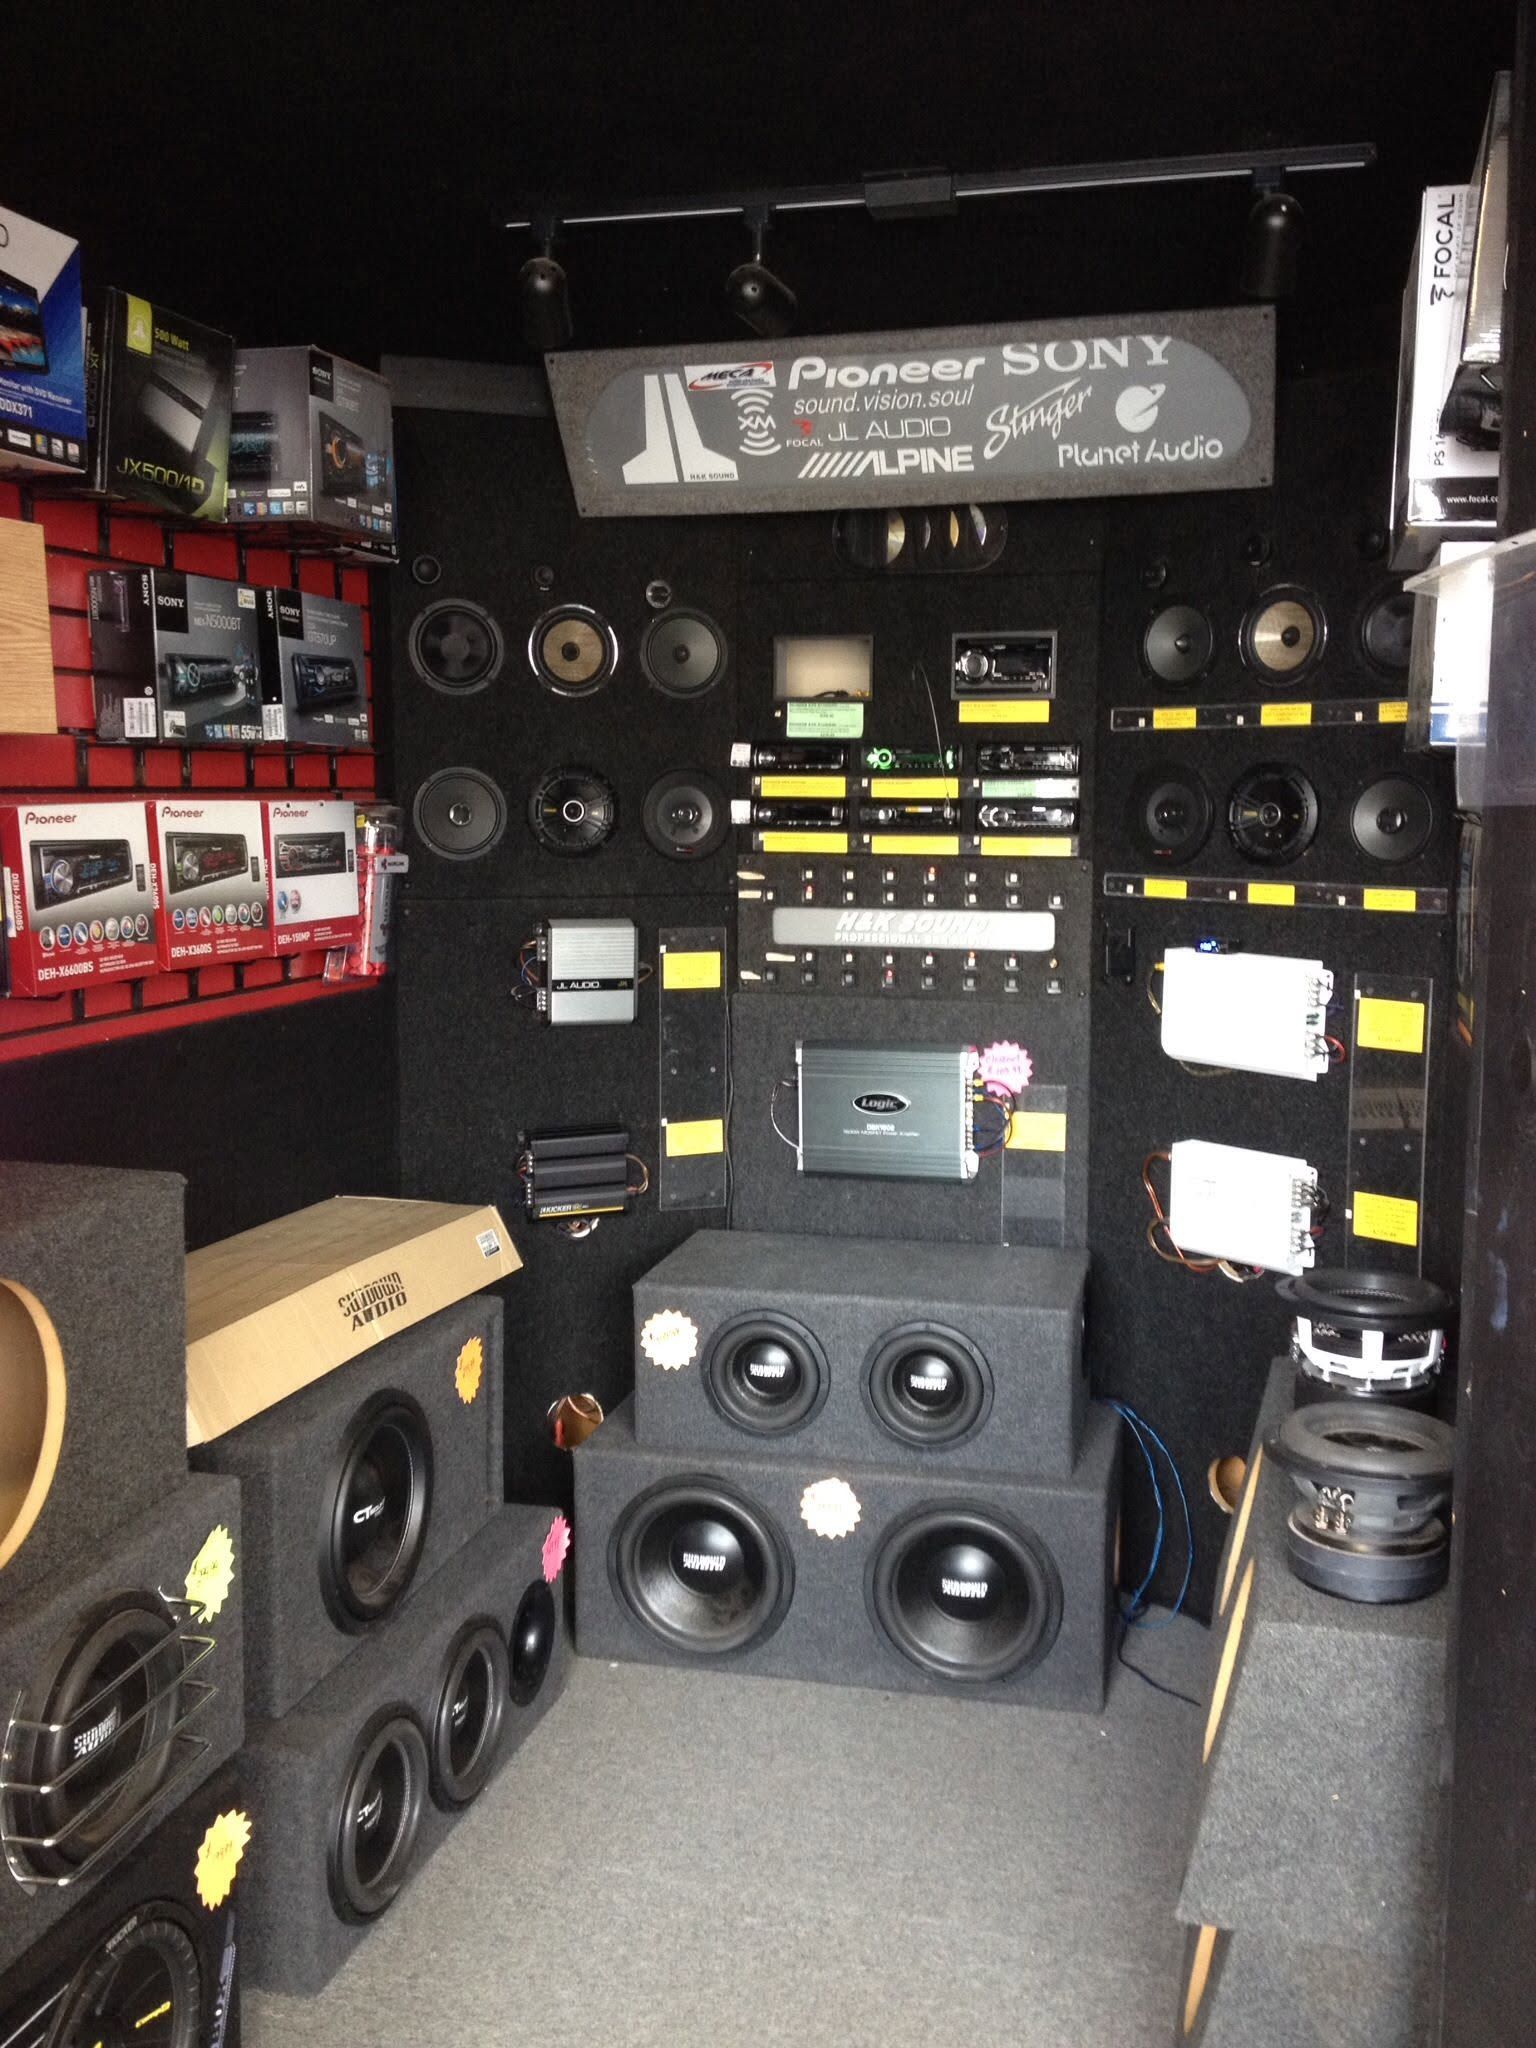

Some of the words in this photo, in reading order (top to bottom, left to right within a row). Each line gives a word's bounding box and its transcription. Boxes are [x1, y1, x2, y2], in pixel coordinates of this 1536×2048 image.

[1434, 194, 1455, 278] FOCAL
[155, 328, 170, 342] 500
[171, 332, 190, 351] Watt
[1002, 335, 1172, 376] SONY
[701, 368, 754, 380] MECA
[788, 356, 985, 391] Pioneer
[794, 384, 975, 416] sound.vision.soul
[738, 415, 777, 431] XM
[828, 421, 860, 442] JL
[866, 416, 951, 440] AUDIO
[984, 377, 1092, 460] Stinger
[786, 438, 824, 448] FOCAL
[1058, 438, 1141, 468] Planet
[1145, 435, 1223, 463] Audio
[116, 457, 205, 494] JX500/1D
[142, 574, 150, 606] SONY
[157, 595, 184, 608] SONY
[266, 590, 274, 619] SONY
[280, 606, 300, 617] SONY
[25, 812, 77, 825] Pioneer
[162, 806, 204, 819] Pioneer
[273, 807, 309, 818] Pioneer
[836, 911, 896, 933] H&K
[835, 932, 921, 945] PROFESSIONAL
[38, 961, 94, 981] DEH-X6600BS
[556, 982, 568, 990] JL
[569, 981, 600, 989] AUDIO
[861, 1098, 898, 1110] Logic
[338, 1272, 404, 1317] SUNDOWN
[352, 1291, 407, 1332] AUDIO
